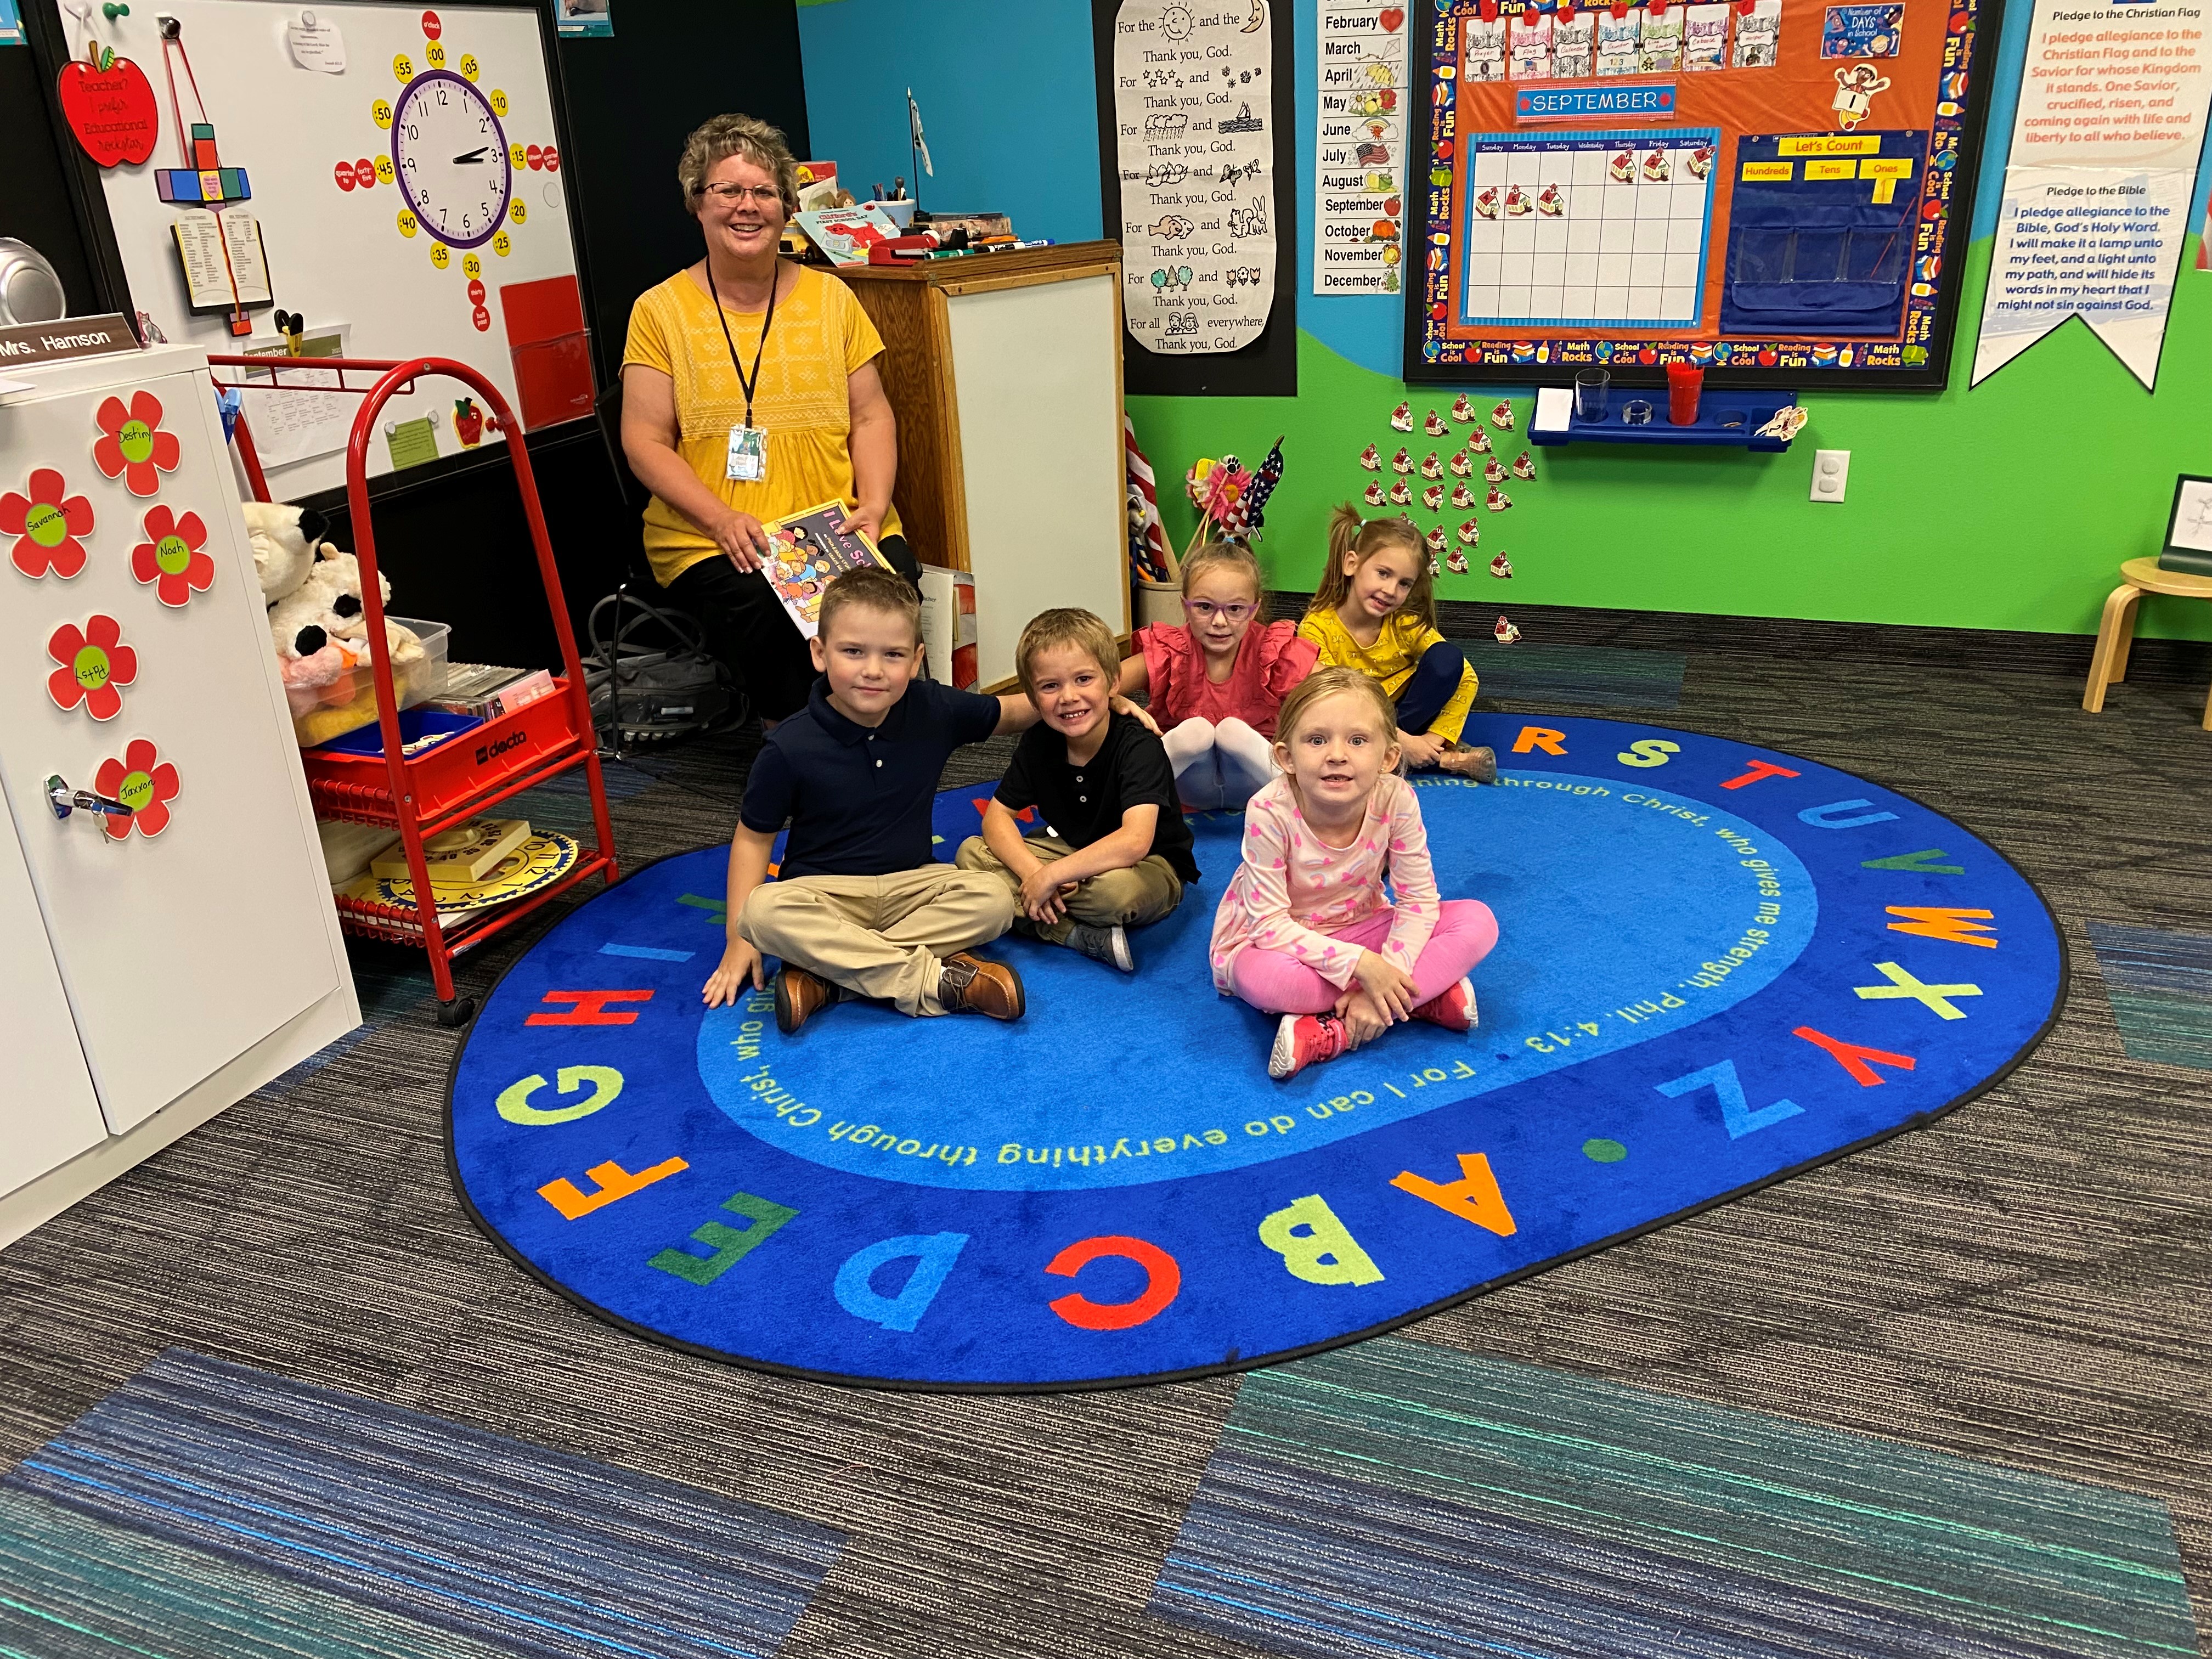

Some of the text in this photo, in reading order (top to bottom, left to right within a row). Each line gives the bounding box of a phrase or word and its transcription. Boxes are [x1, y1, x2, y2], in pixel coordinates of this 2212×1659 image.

[1874, 6, 1883, 15] of
[2053, 8, 2200, 21] Pledge to the Christian Flag
[1118, 14, 1240, 33] For the and the
[1326, 16, 1378, 30] February
[1852, 16, 1876, 30] DAYS
[1435, 21, 1444, 47] Math
[1445, 18, 1455, 51] Rocks
[2042, 29, 2202, 45] I pledge allegiance to the
[428, 48, 444, 60] :00
[1143, 45, 1232, 63] Thank you, God.
[1325, 41, 1361, 55] March
[396, 63, 411, 75] :55
[463, 60, 477, 75] :05
[1119, 71, 1210, 88] For and
[1325, 69, 1352, 84] April
[78, 78, 128, 92] Teacher?
[493, 97, 506, 108] :10
[1323, 97, 1346, 111] May
[1533, 92, 1657, 111] SEPTEMBER
[374, 107, 391, 120] :50
[84, 119, 148, 134] Educational
[1323, 123, 1351, 136] June
[2026, 129, 2185, 144] liberty to all who believe.
[1547, 142, 1570, 150] Tuesday
[1649, 140, 1669, 148] Friday
[1796, 140, 1863, 151] Let's Count
[512, 151, 523, 161] :15
[1323, 149, 1346, 164] July
[377, 163, 392, 175] :45
[1746, 167, 1788, 175] Hundreds
[1874, 165, 1898, 173] Ones
[1323, 175, 1363, 190] August
[1926, 171, 1939, 197] Cool
[1942, 171, 1952, 200] School
[2047, 185, 2146, 197] Pledge to the Bible
[511, 206, 524, 216] :20
[1325, 199, 1384, 214] September
[399, 217, 415, 229] :40
[2017, 223, 2051, 234] Bible,
[2091, 222, 2120, 233] Holy
[2123, 222, 2160, 232] Word.
[1325, 225, 1370, 237] October
[1917, 224, 1933, 251] Fun
[1932, 220, 1946, 253] Reading
[495, 237, 509, 249] :25
[432, 249, 447, 261] :35
[1325, 249, 1383, 261] November
[465, 261, 479, 272] :30
[1325, 274, 1381, 286] December
[1997, 300, 2154, 312] might not sin against God.
[1131, 317, 1264, 330] For all everywhere,
[0, 330, 111, 357] Mrs. Hamson
[1482, 342, 1511, 351] Reading
[1567, 342, 1590, 351] Math
[244, 348, 287, 357] eptember
[1441, 353, 1462, 362] Cool
[1484, 353, 1508, 363] Fun
[1562, 352, 1592, 362] Rocks
[116, 428, 151, 443] Destiny
[28, 506, 71, 532] Savannah
[160, 544, 184, 556] Noah
[76, 664, 109, 686] Patsy
[121, 779, 156, 799] Jaxxon
[1496, 776, 1780, 1053] through Christ, who gives me strength. Phil. 4:13
[1513, 726, 1998, 1140] R S T W X Z
[731, 1021, 1477, 1169] For I can do everything through Christ, who
[495, 990, 1516, 1330] A B C F G H
